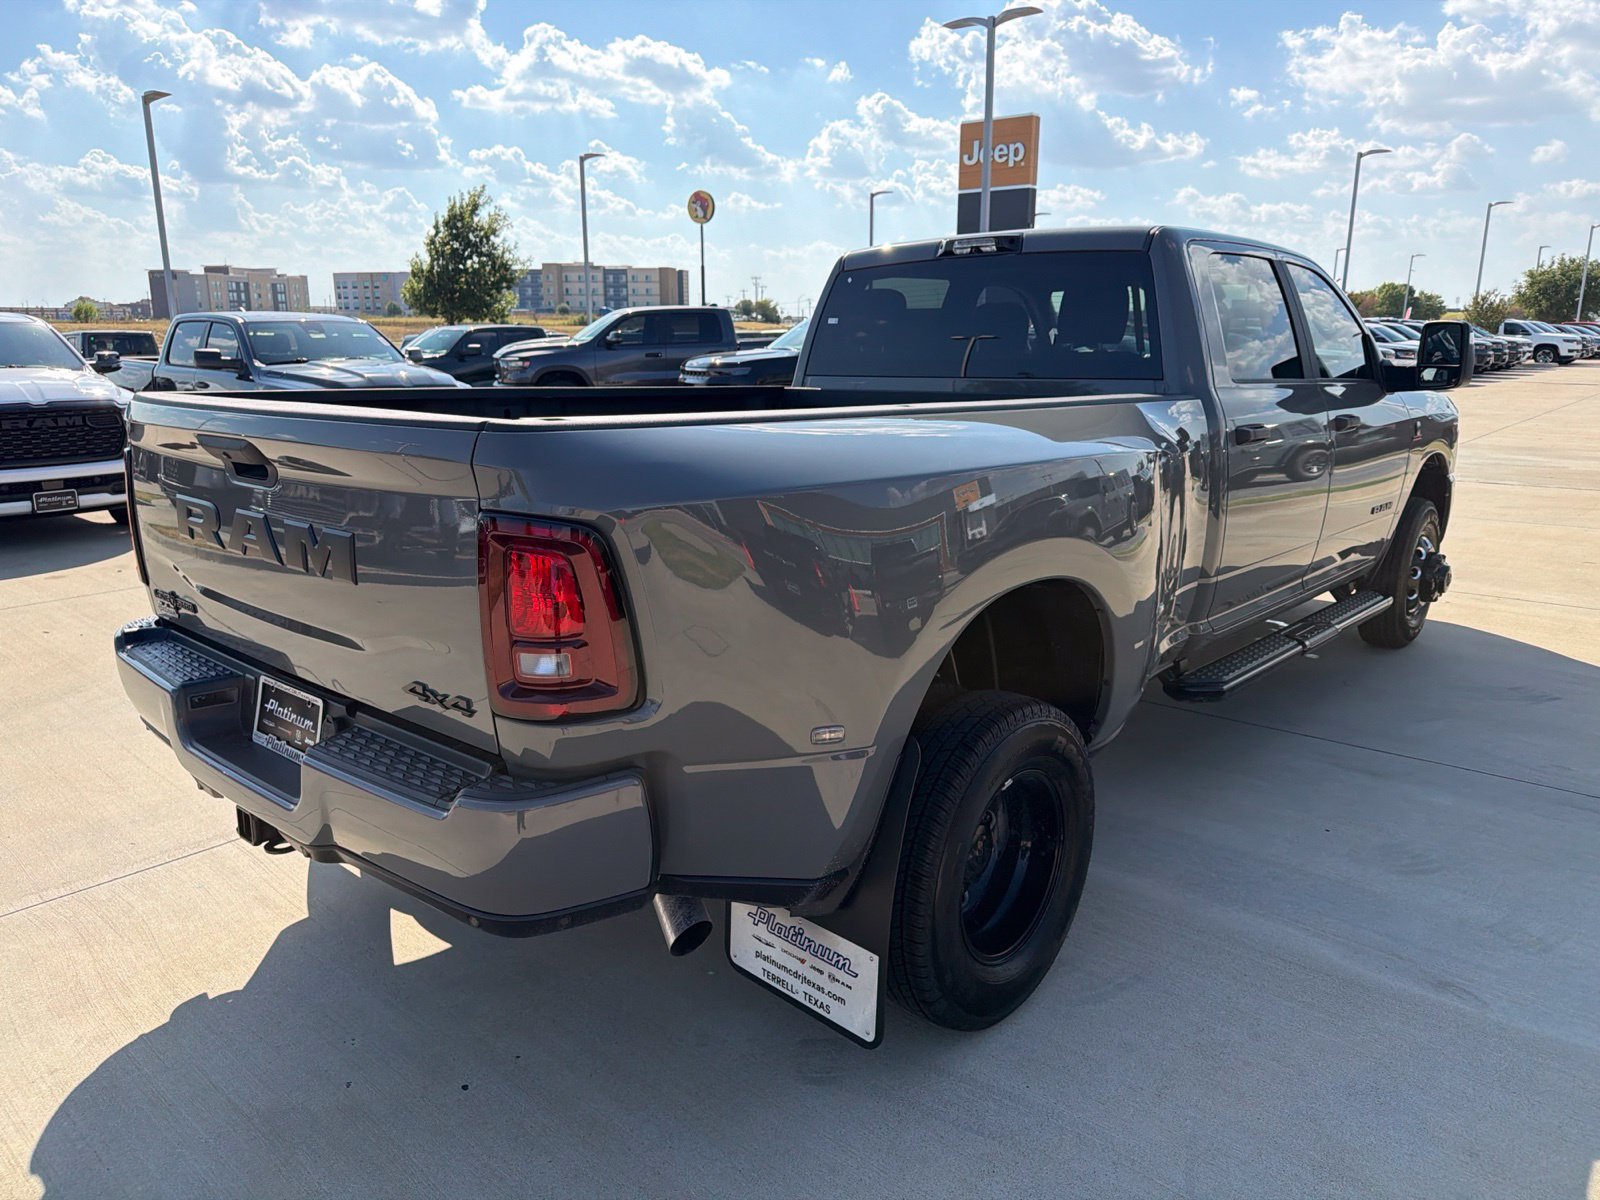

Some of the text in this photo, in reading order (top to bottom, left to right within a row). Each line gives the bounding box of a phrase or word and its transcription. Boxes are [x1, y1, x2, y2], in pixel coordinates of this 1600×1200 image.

[1, 415, 84, 430] RAM
[176, 494, 358, 585] RAM
[264, 698, 315, 733] Platinum
[266, 735, 302, 763] Platinum
[747, 906, 859, 978] Platinum
[755, 950, 846, 1006] platinumcdrjtexas.com
[809, 963, 825, 976] Jeep
[835, 978, 853, 991] RAM
[803, 991, 831, 1015] TEXAS
